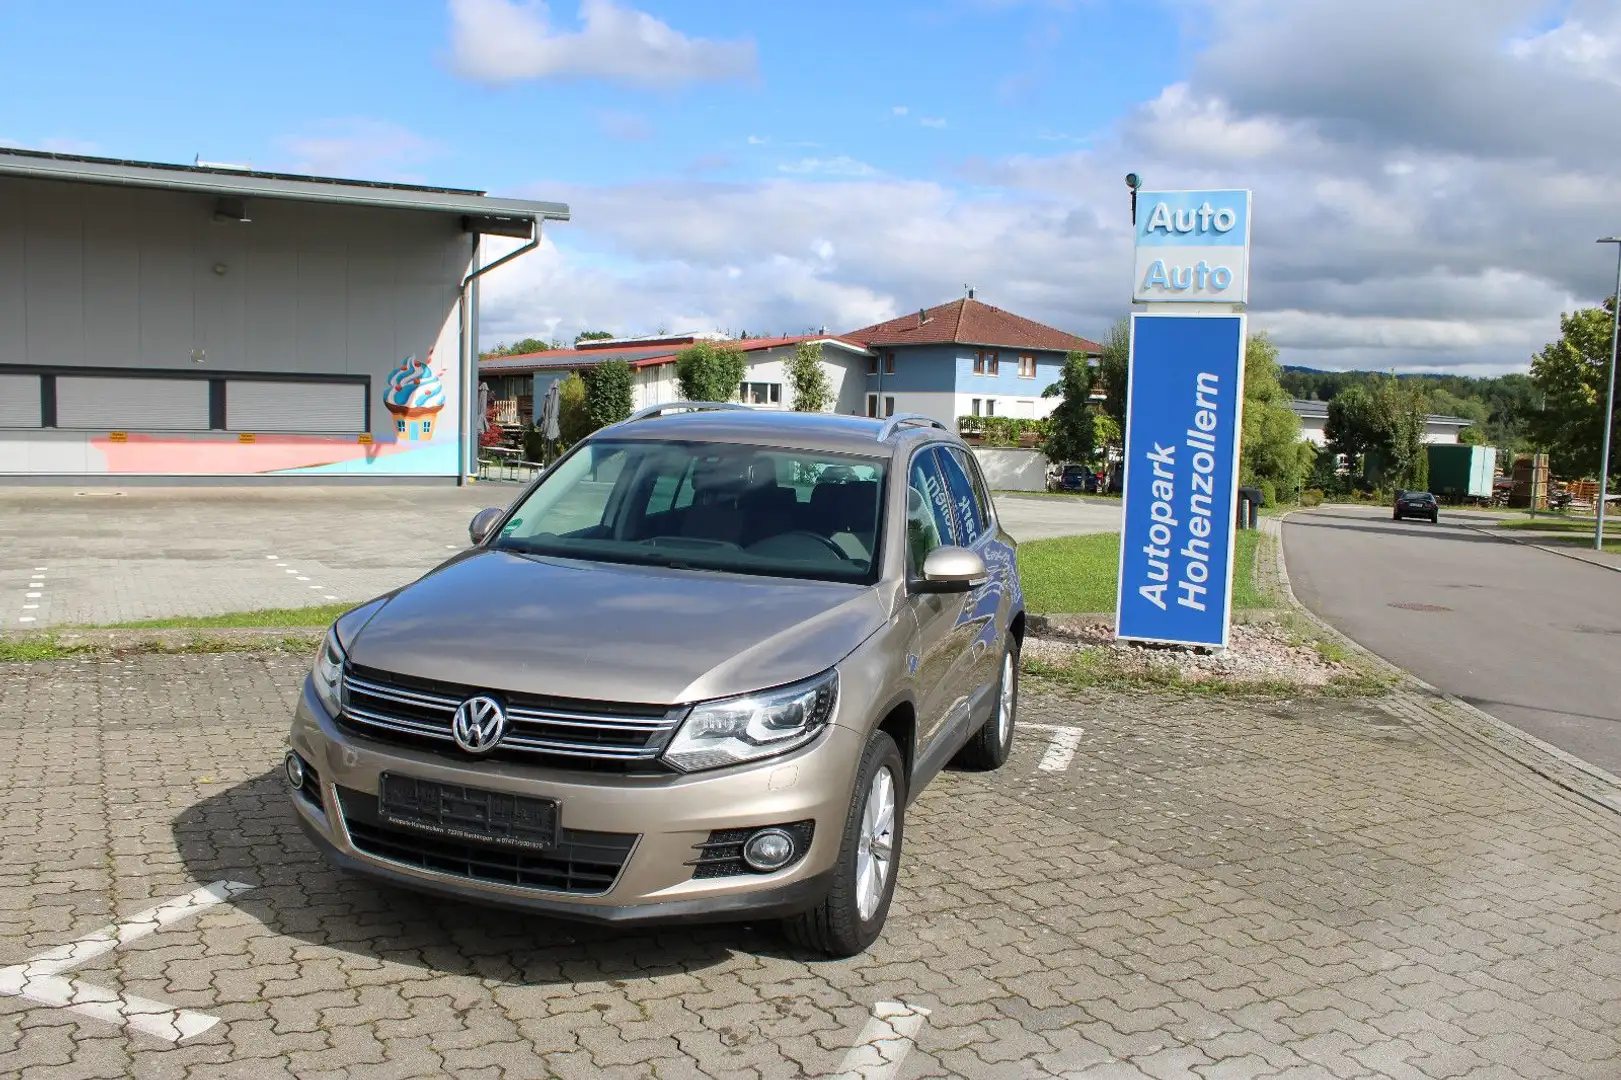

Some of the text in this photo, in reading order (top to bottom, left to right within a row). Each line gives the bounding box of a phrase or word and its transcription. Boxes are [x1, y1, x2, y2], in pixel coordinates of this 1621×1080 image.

[1147, 201, 1236, 233] Auto
[1144, 259, 1234, 290] Auto
[1139, 442, 1178, 612] Autopark
[1177, 372, 1220, 612] Hohenzollern
